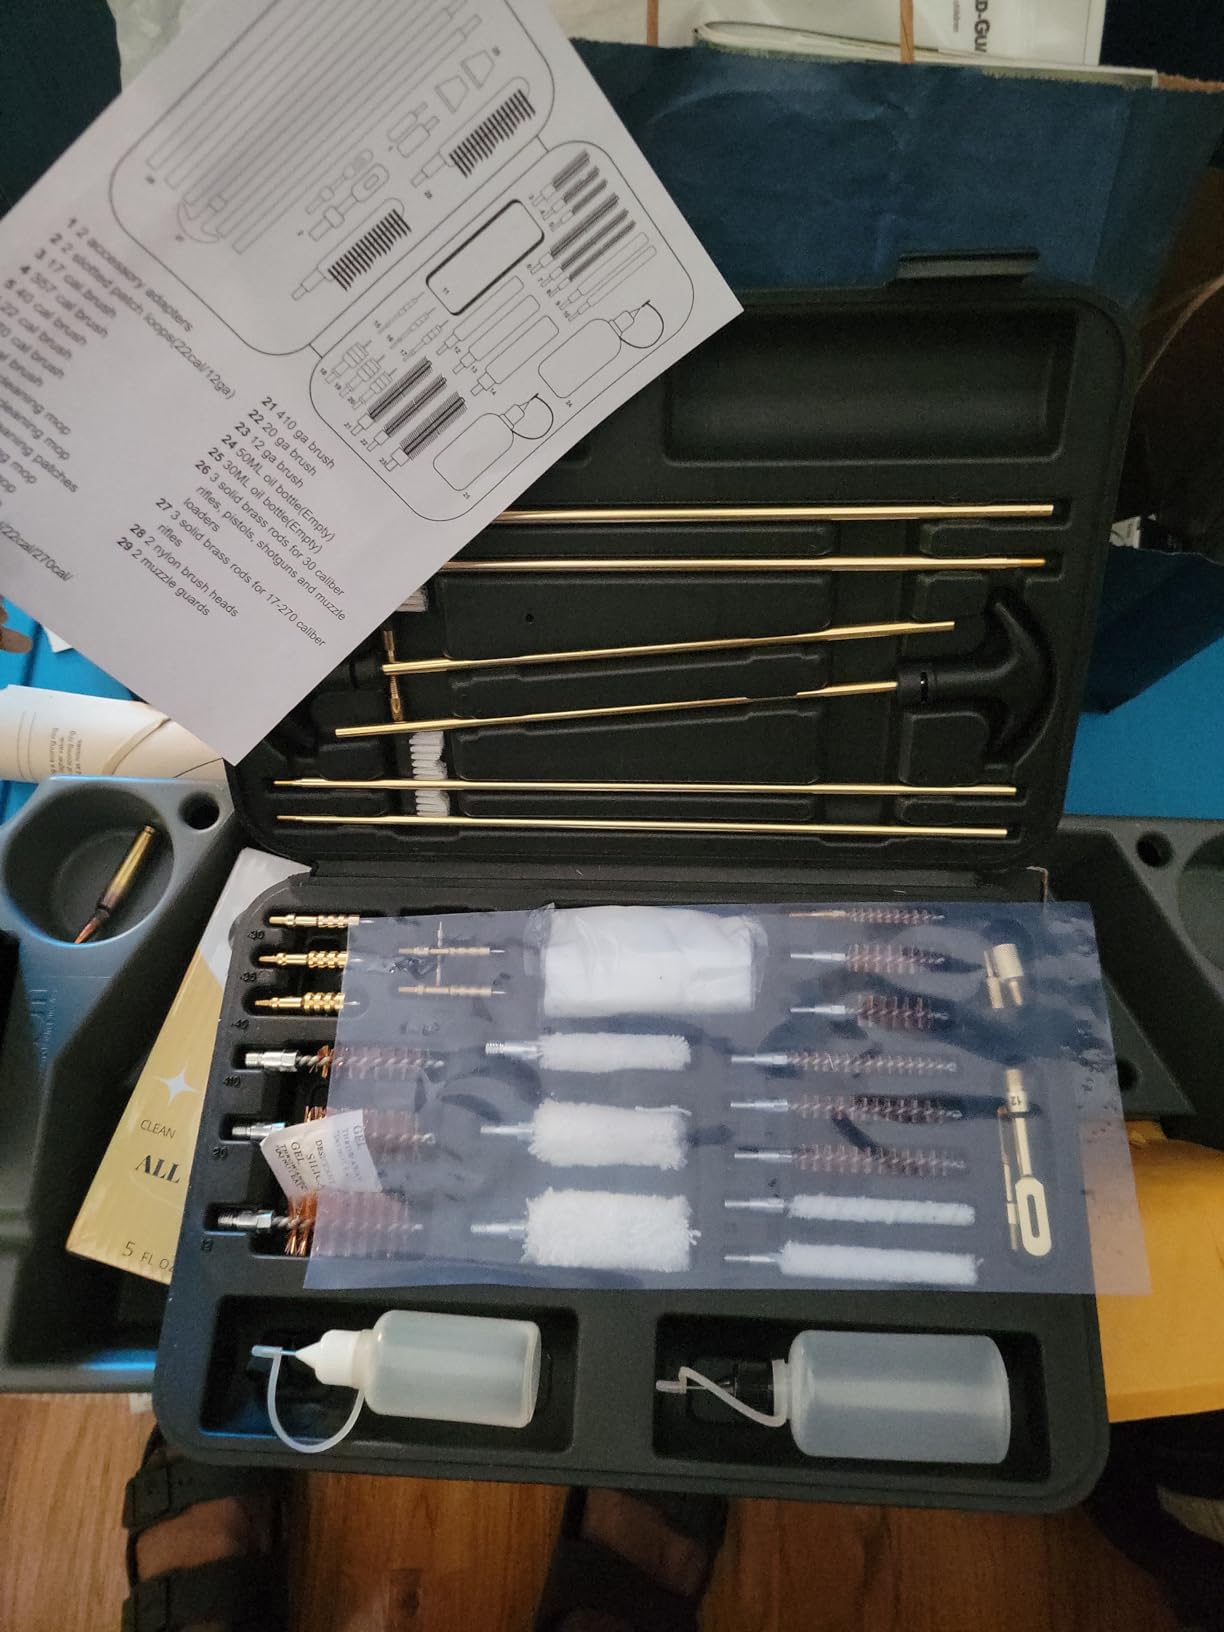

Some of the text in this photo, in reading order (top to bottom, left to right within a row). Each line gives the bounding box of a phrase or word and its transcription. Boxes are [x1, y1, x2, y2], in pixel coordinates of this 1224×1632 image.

[43, 411, 71, 436] mop
[43, 436, 71, 461] mop
[247, 408, 318, 476] 22 20 ga brush
[261, 396, 336, 469] 21 410 ga brush
[10, 461, 38, 485] mop
[32, 453, 79, 493] patches
[234, 421, 304, 488] 23 12 ga brush
[183, 497, 221, 532] loaders
[207, 446, 323, 555] 25 30ML oil bottle(Empty)
[221, 434, 336, 543] 24 50ML oil bottle(Empty)
[157, 523, 183, 547] rifles
[194, 459, 345, 596] 26 3 solid brass rods for 30 caliber
[195, 485, 346, 621] rifles, pistols, shotguns and muzzle
[117, 536, 211, 617] 29 2 muzzle guards
[129, 523, 239, 617] 28 2 nylon brush heads
[155, 497, 326, 647] 27 3 solid brass rods for 17-270 caliber
[140, 1119, 176, 1139] CLEAN
[290, 1141, 304, 1163] GEL
[135, 1154, 180, 1184] ALL
[122, 1241, 135, 1257] 5
[140, 1252, 153, 1266] FL
